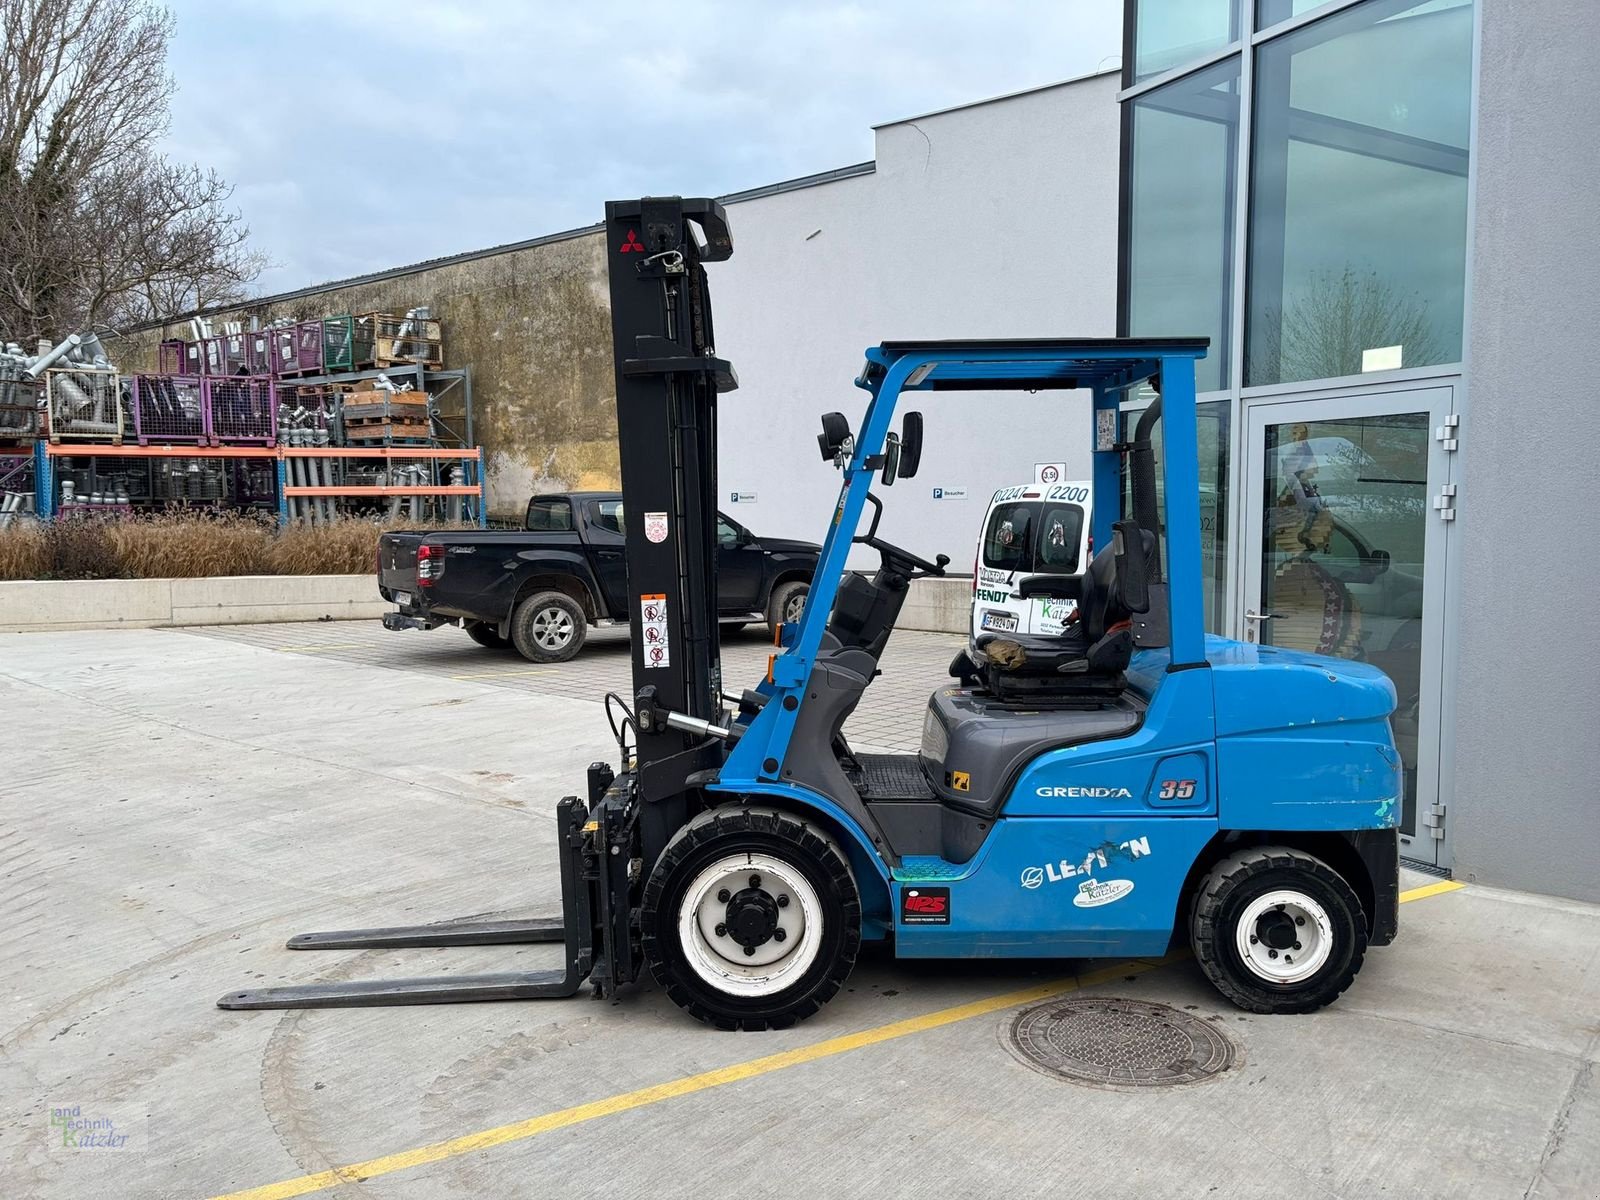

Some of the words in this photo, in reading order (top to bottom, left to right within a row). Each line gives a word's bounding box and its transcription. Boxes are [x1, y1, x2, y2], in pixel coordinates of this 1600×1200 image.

[1044, 471, 1056, 480] 3,5t
[995, 486, 1029, 503] 02247
[1050, 486, 1089, 502] 2200
[977, 589, 1009, 603] FENDT
[1158, 779, 1198, 800] 35
